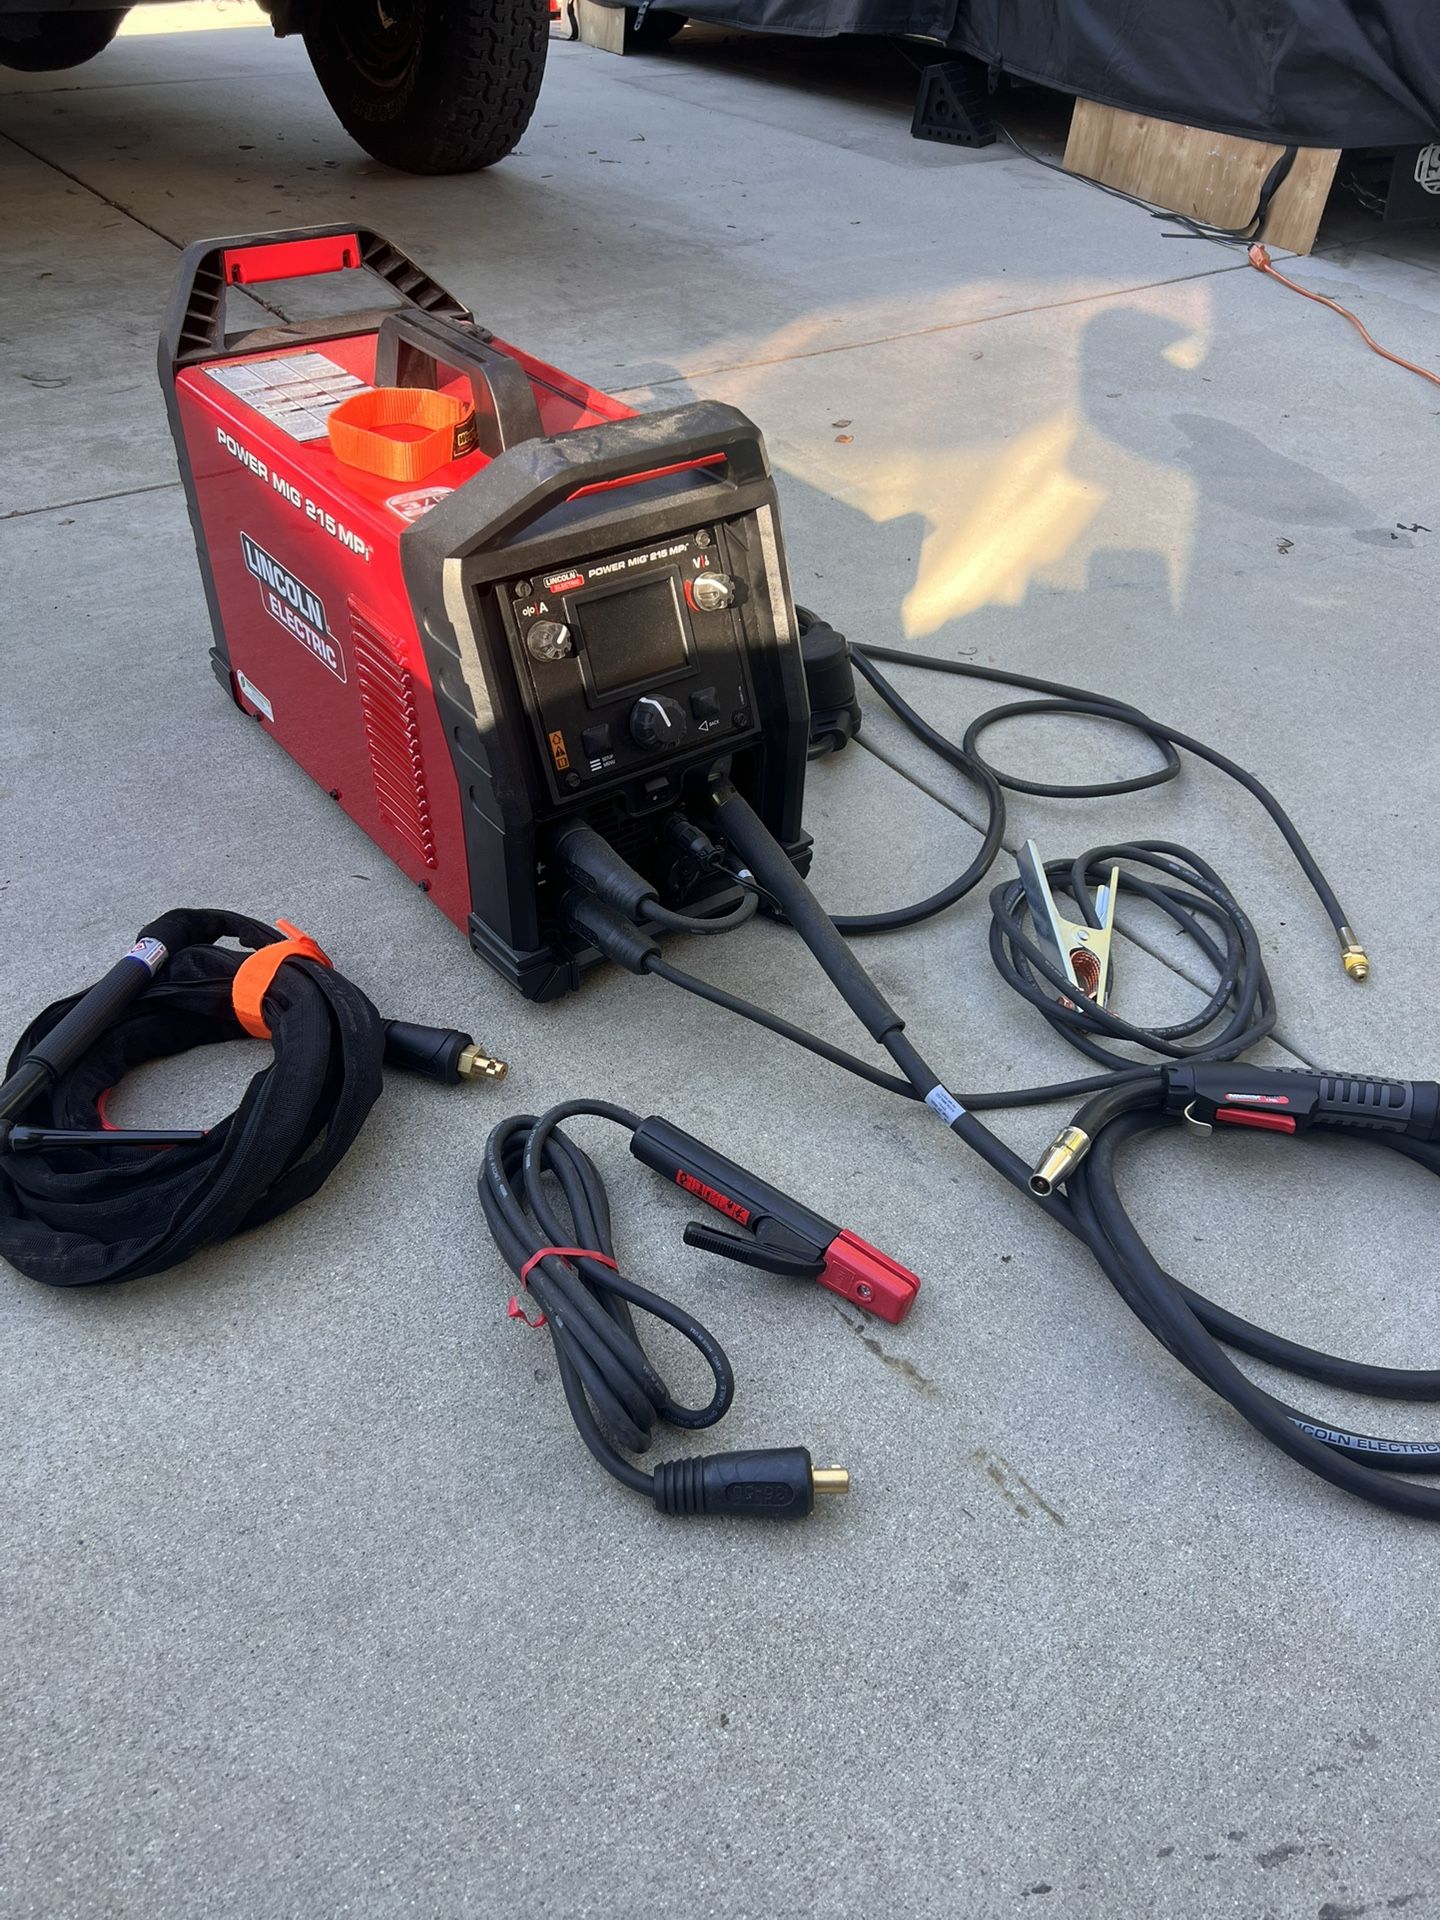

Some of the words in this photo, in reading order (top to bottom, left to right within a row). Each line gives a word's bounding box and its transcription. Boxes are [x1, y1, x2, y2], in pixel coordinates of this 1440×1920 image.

[217, 427, 269, 482] POWER
[272, 472, 302, 508] MIG
[305, 499, 336, 536] 215
[588, 561, 625, 578] POWER
[628, 555, 648, 567] MIG
[650, 548, 668, 561] 215
[245, 540, 322, 631] LINCOLN
[545, 571, 576, 586] LINCOLN
[539, 602, 549, 614] A
[269, 592, 337, 669] ELECTRIC
[708, 719, 720, 727] BACK
[601, 754, 614, 762] SETUP
[603, 759, 616, 767] MENU
[1299, 1423, 1350, 1445] COLN
[1357, 1439, 1438, 1453] ELECTRIC
